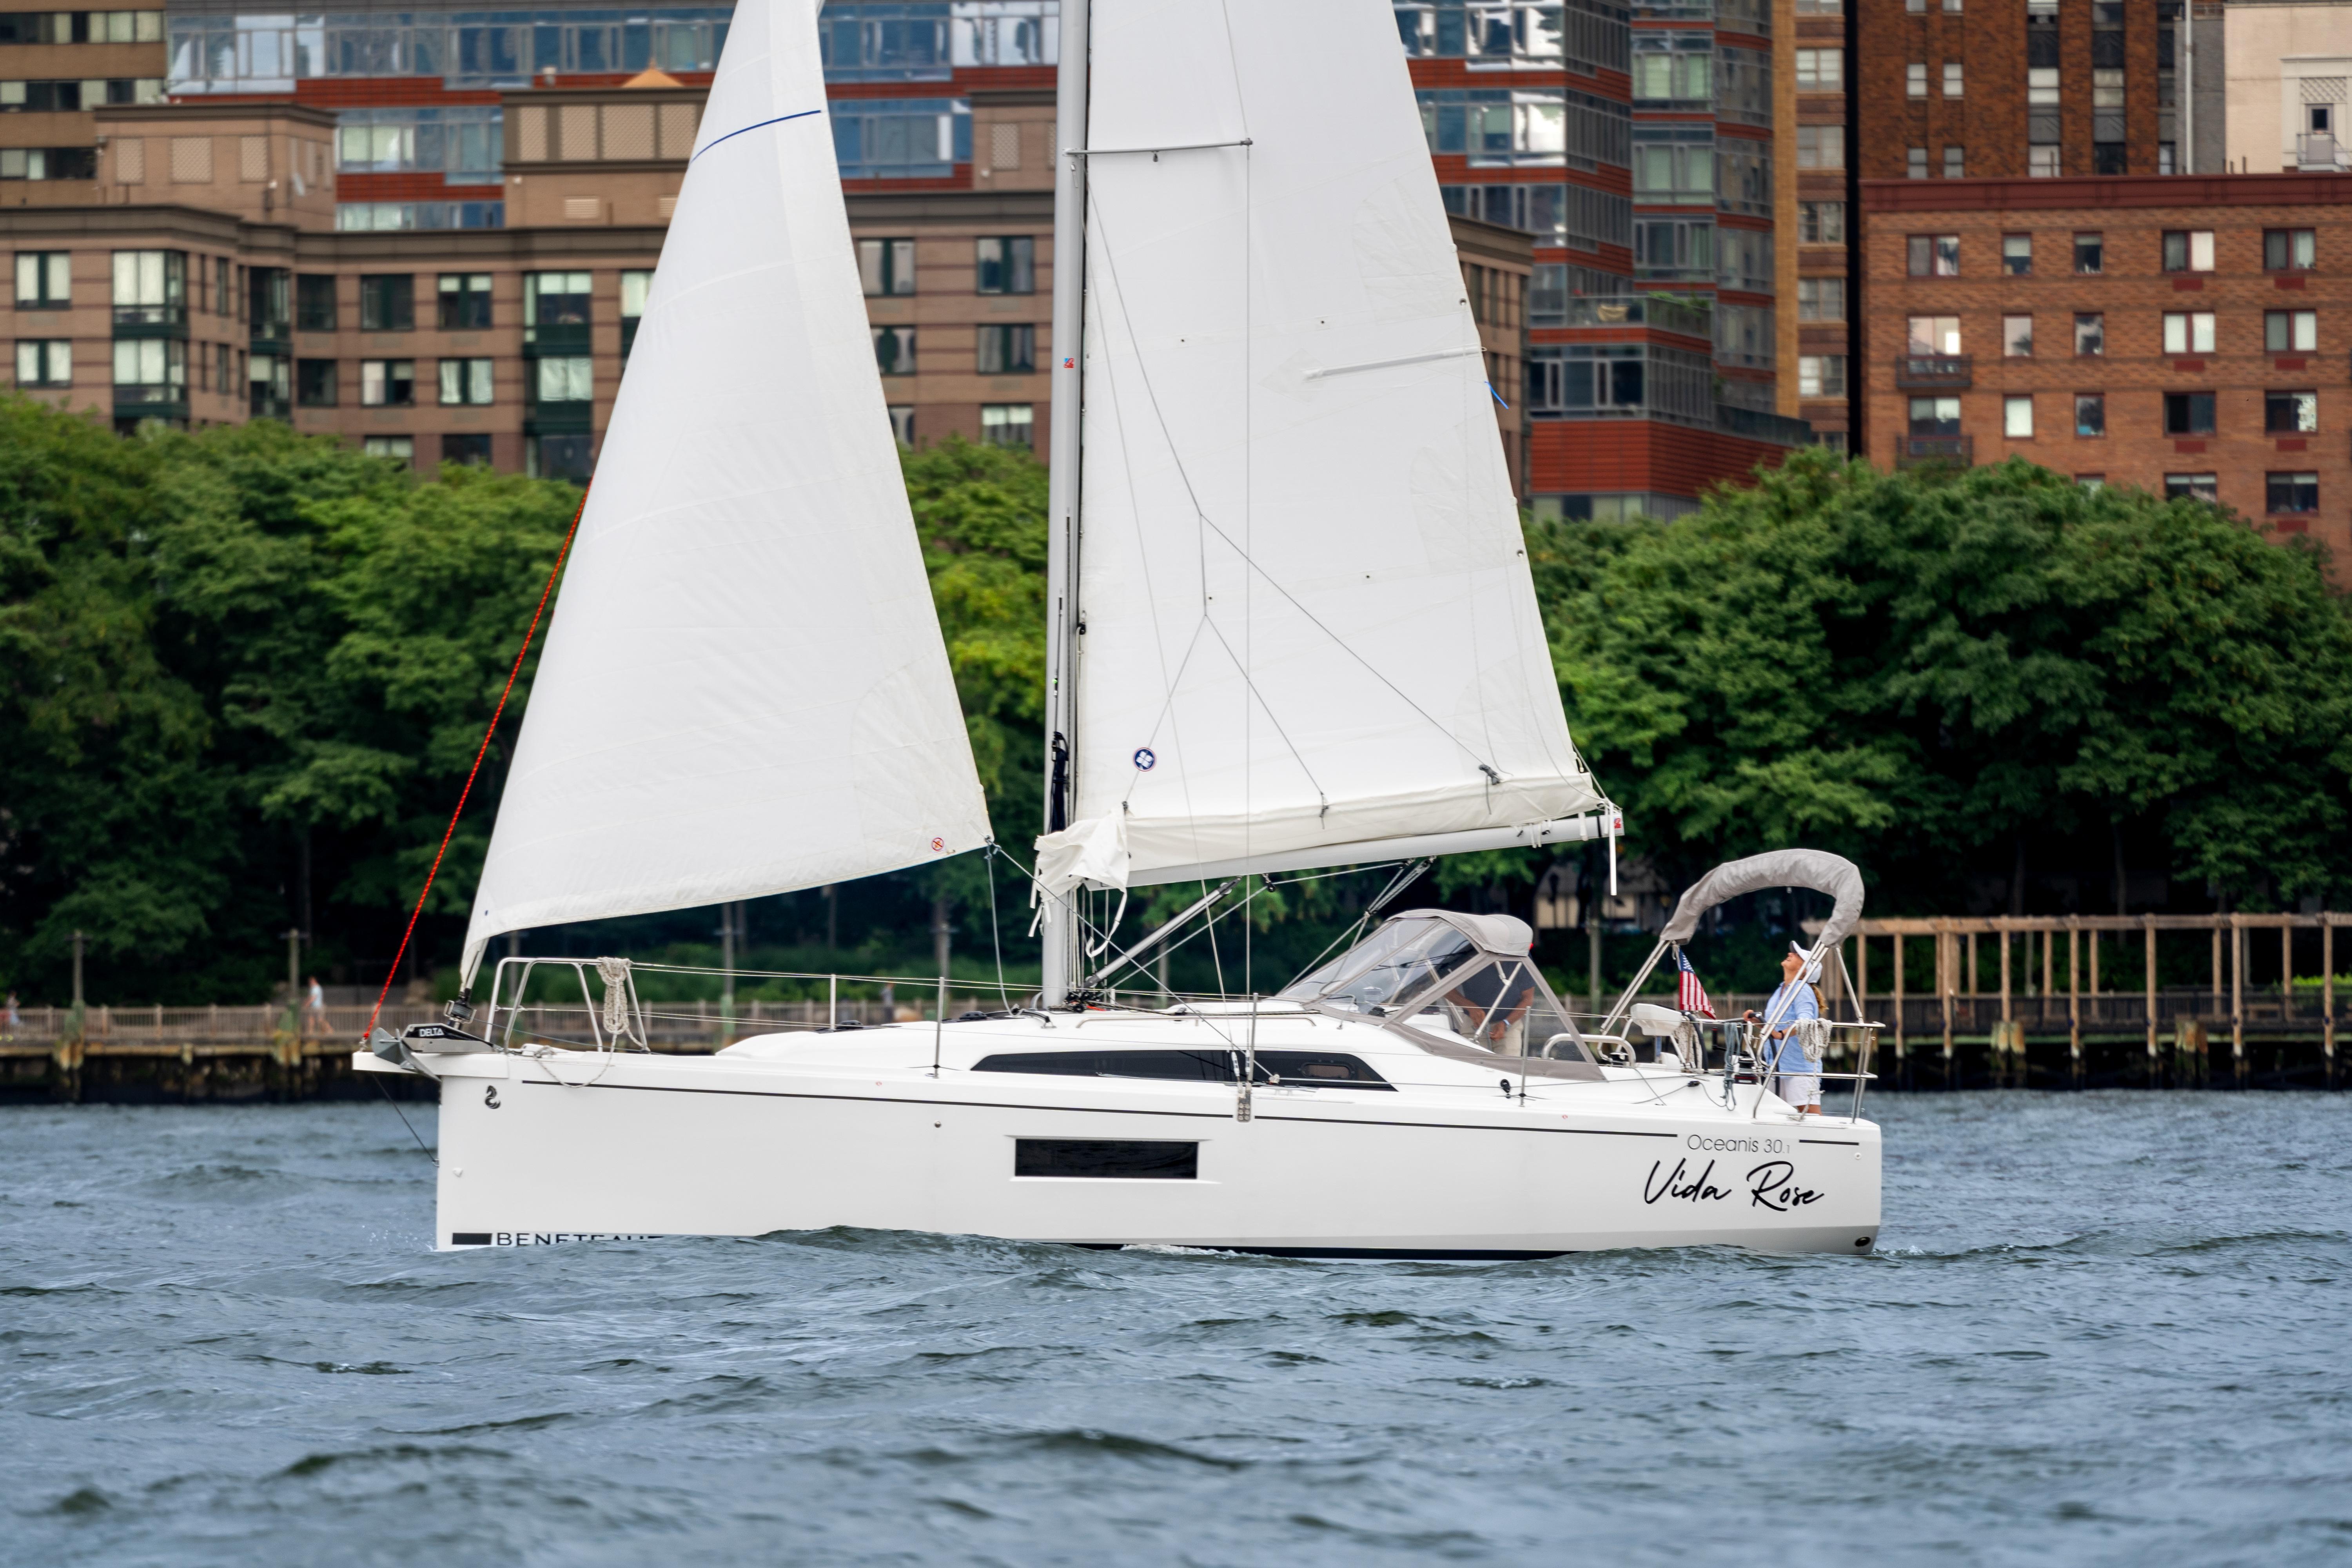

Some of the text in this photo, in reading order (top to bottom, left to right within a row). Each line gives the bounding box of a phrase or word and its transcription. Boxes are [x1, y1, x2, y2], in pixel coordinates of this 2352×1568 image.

[419, 1028, 445, 1037] DELTA
[1687, 1134, 1790, 1154] Oceanis 30.1
[1644, 1158, 1825, 1212] Vida Rose
